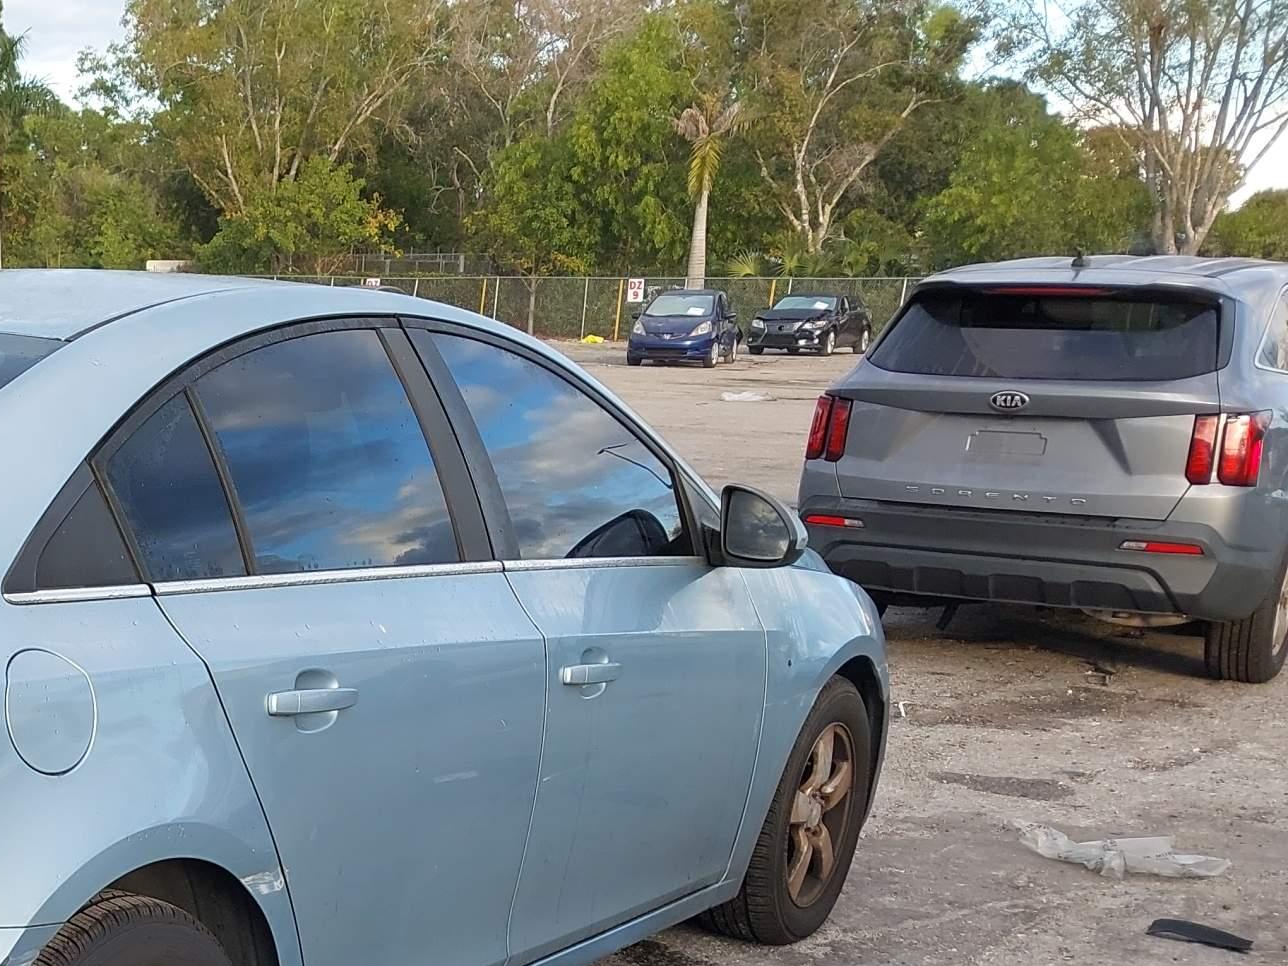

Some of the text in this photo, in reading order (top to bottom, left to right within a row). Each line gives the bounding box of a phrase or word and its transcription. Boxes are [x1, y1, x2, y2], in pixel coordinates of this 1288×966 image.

[629, 281, 643, 290] DZ
[632, 290, 639, 300] 9
[996, 395, 1022, 407] KIA
[905, 485, 1087, 505] SORENTO
